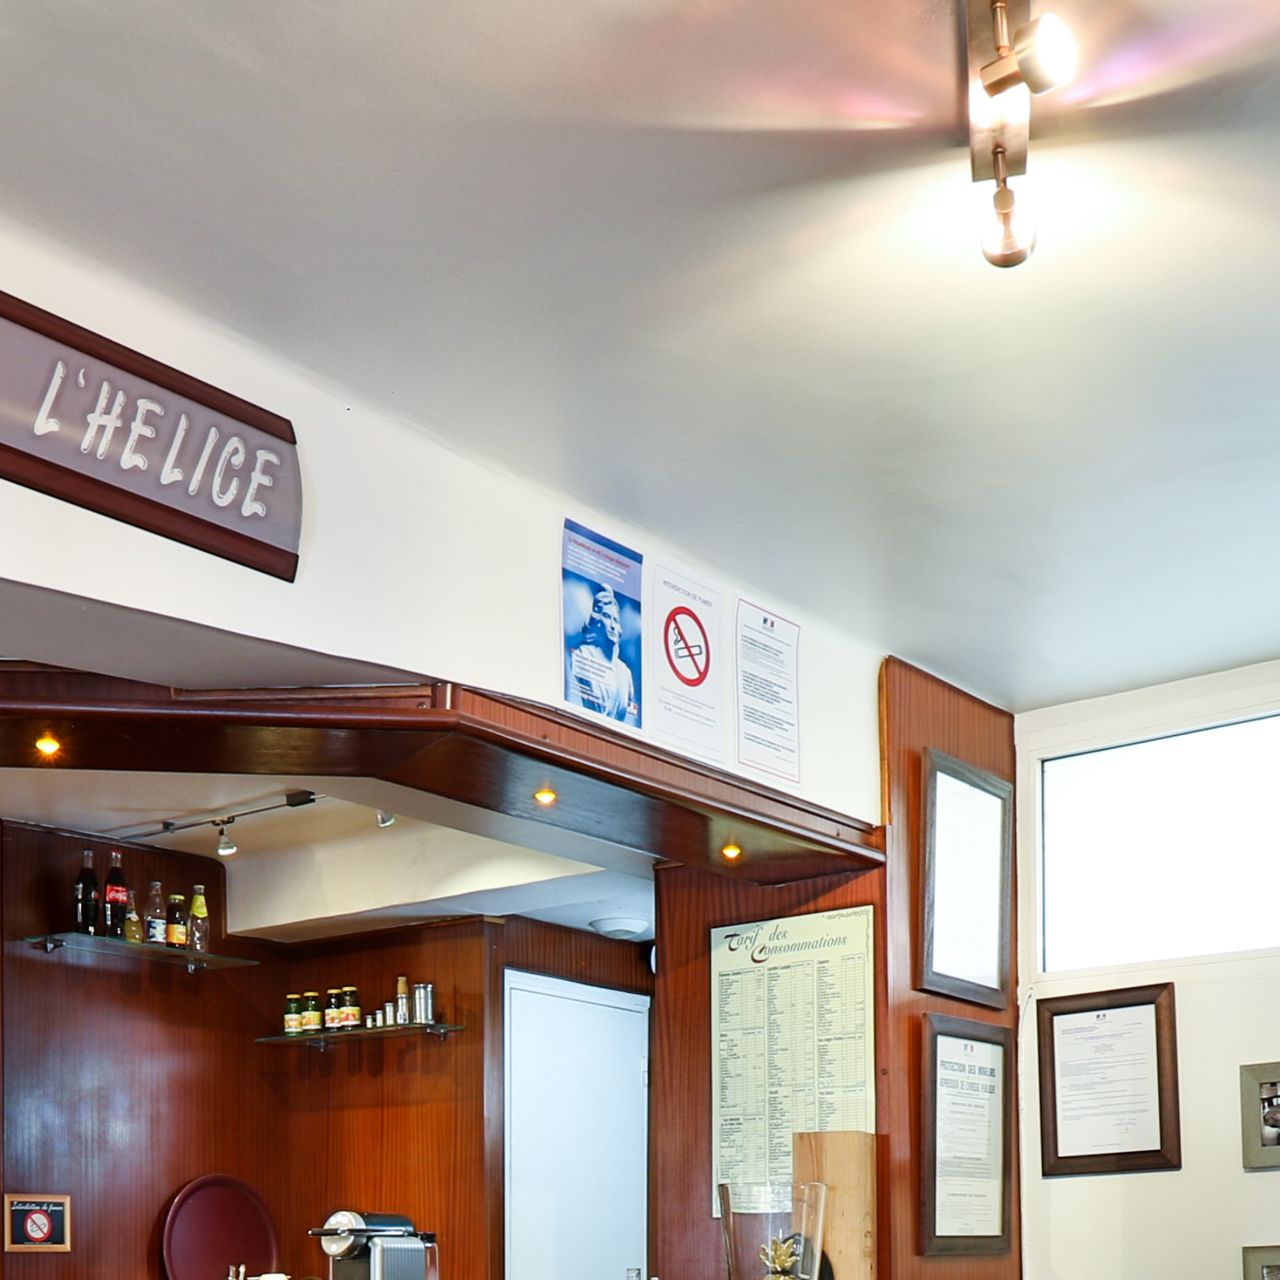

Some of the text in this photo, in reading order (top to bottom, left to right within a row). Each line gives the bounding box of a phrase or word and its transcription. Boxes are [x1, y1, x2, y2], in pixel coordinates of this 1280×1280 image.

[33, 360, 281, 518] L'HELICE
[723, 924, 788, 952] Tarif des
[750, 934, 848, 964] Consommations
